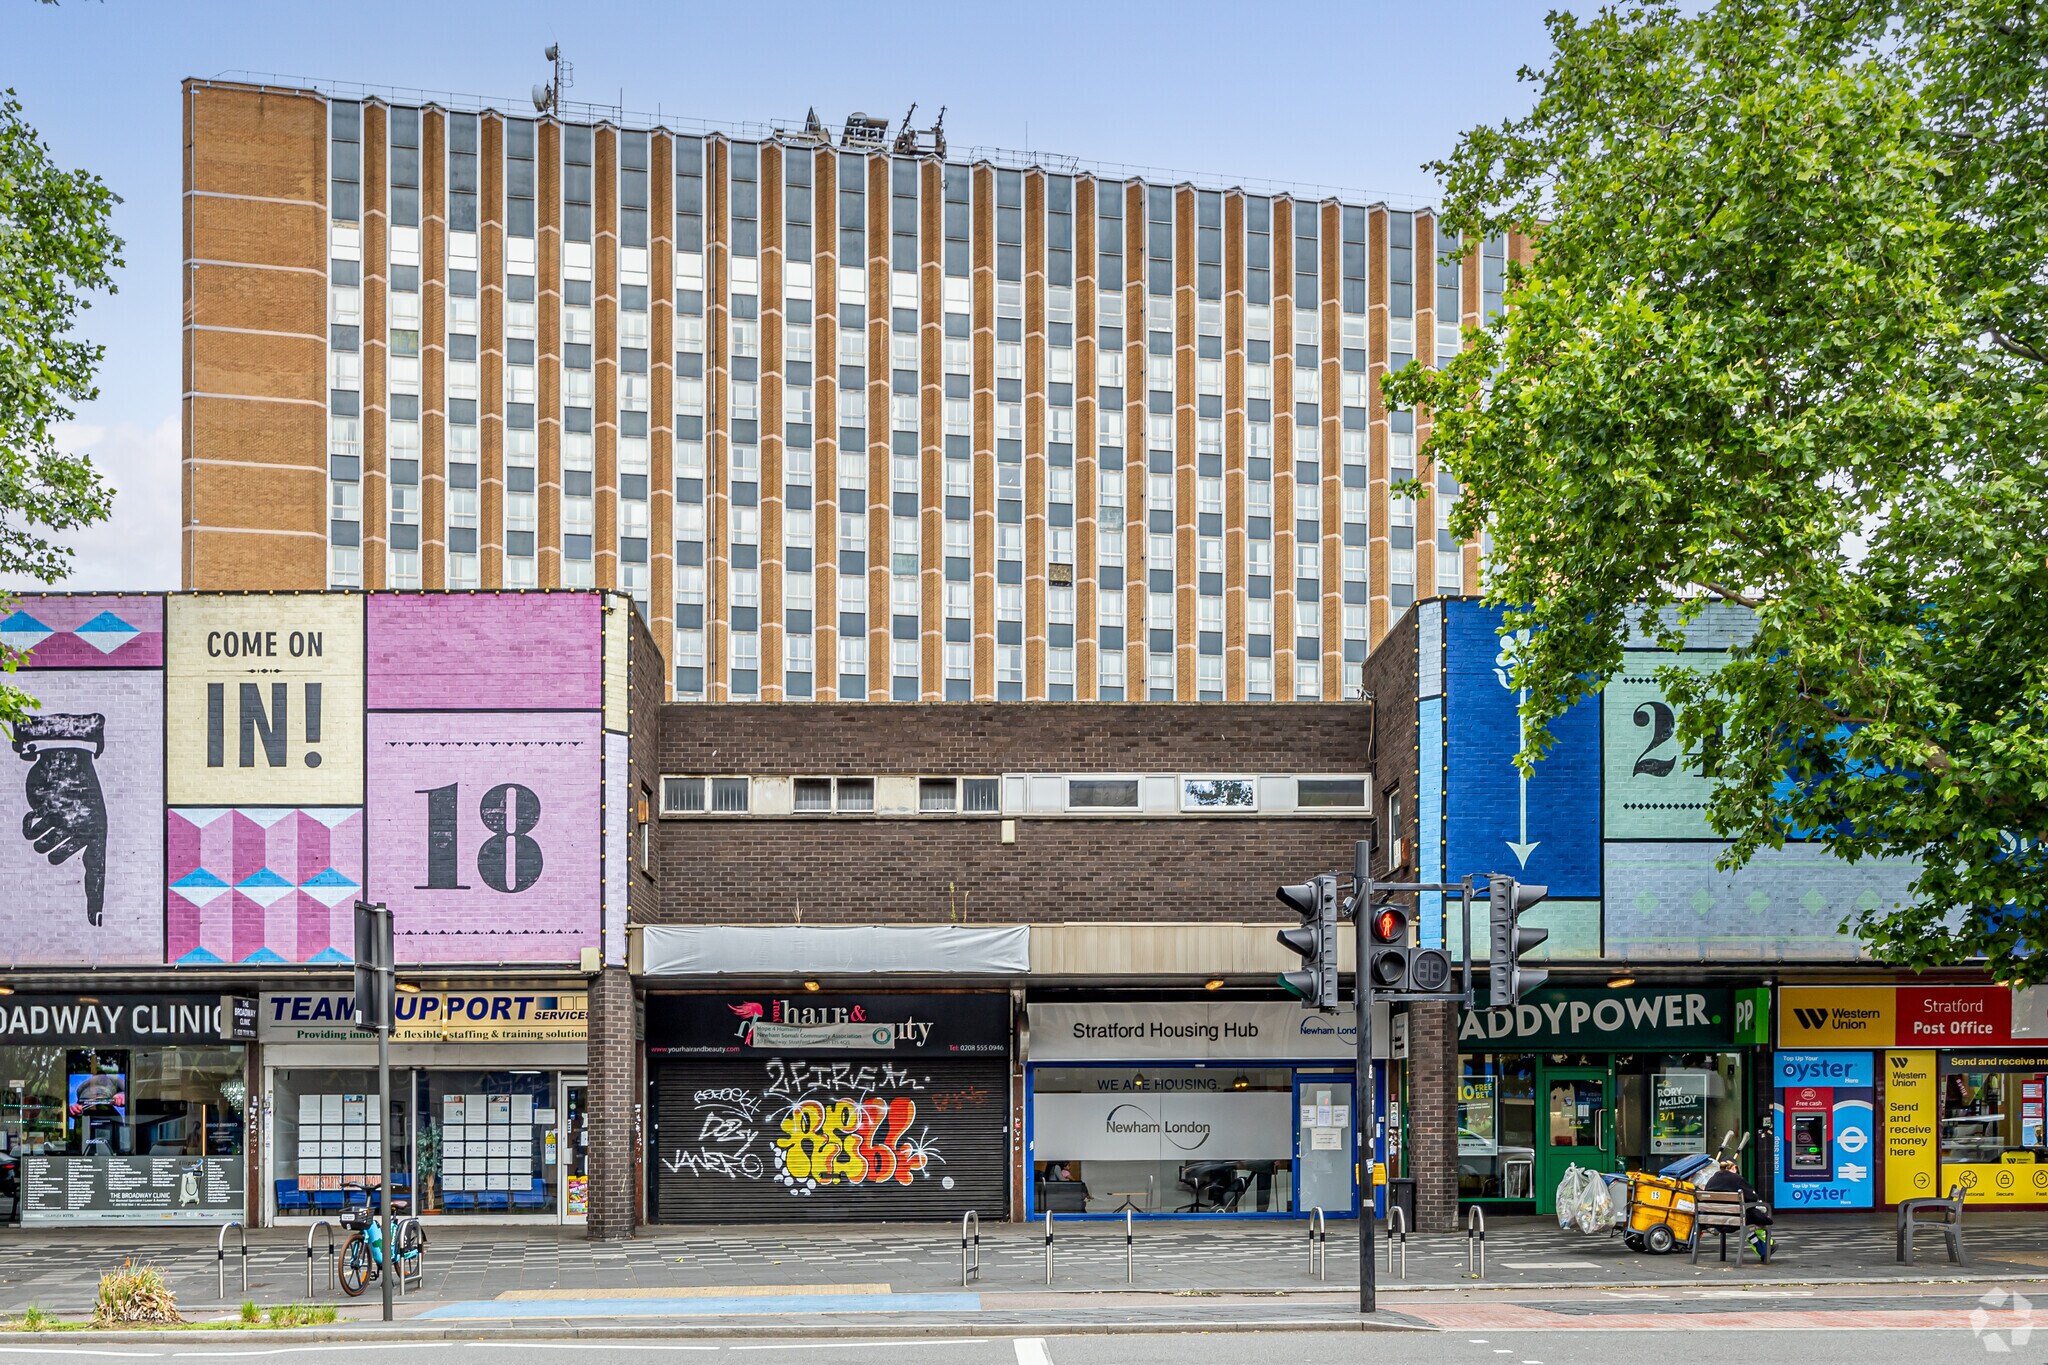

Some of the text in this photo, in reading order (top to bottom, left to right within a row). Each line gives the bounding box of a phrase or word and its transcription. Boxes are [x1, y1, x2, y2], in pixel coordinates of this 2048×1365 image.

[207, 631, 324, 658] COME ON
[207, 682, 323, 769] IN!
[414, 782, 544, 894] 18
[270, 996, 535, 1022] TEAM UPPORT
[1923, 998, 1984, 1013] Stratford
[850, 1004, 867, 1023] &
[1457, 993, 1722, 1041] ADDYPOWER.
[1831, 1008, 1881, 1019] Western
[1300, 1025, 1357, 1035] Newham Lond
[1831, 1019, 1867, 1030] Union
[1913, 1021, 1994, 1035] Post Office
[296, 1029, 347, 1041] Providing
[404, 1029, 442, 1040] flexible
[448, 1029, 489, 1041] staffing
[490, 1030, 499, 1039] &
[502, 1029, 544, 1041] training
[800, 1033, 831, 1041] Community
[893, 1016, 934, 1047] uty
[1072, 1022, 1259, 1042] Stratford Housing Hub
[650, 1045, 740, 1054] www.yourhairandbeauty.com
[1951, 1057, 1977, 1066] Send
[1978, 1057, 1997, 1066] and
[1998, 1057, 2035, 1066] receive
[1782, 1059, 1855, 1083] oyster
[1892, 1071, 1927, 1079] Western
[1097, 1078, 1221, 1091] WE ARE HOUSING.
[1474, 1083, 1493, 1092] FREE
[1892, 1079, 1917, 1087] Union
[1475, 1090, 1490, 1099] BET
[1657, 1086, 1683, 1098] RORY
[1658, 1094, 1697, 1107] McILROY
[1889, 1102, 1919, 1111] Send
[1659, 1111, 1675, 1121] 3/1
[1889, 1114, 1911, 1123] and
[1106, 1121, 1211, 1133] Newham London
[1889, 1125, 1932, 1134] receive
[1773, 1135, 1781, 1152] Stop
[1889, 1137, 1928, 1147] money
[1889, 1147, 1916, 1156] here
[1791, 1186, 1848, 1205] oyster
